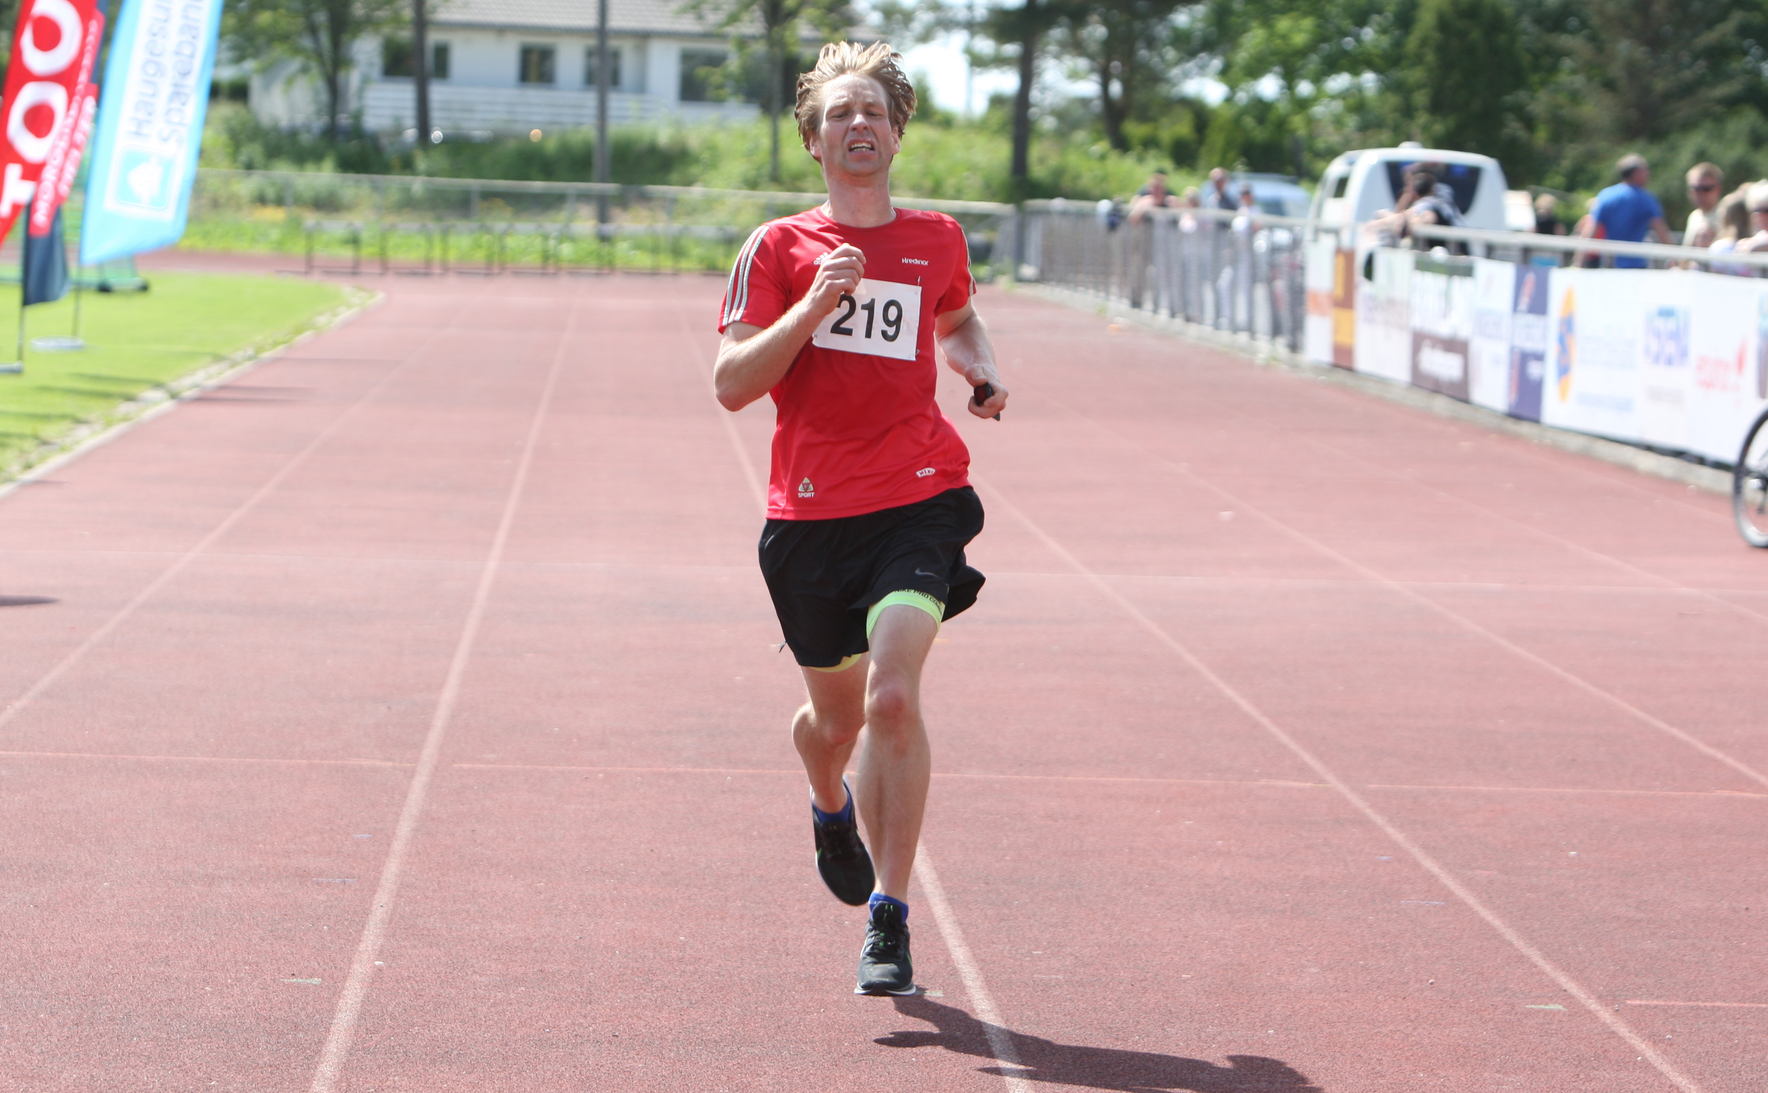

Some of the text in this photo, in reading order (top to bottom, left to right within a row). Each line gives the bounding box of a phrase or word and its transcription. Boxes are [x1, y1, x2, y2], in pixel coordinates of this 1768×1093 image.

[129, 0, 173, 138] Haugesu
[156, 0, 207, 144] Spareban
[830, 291, 903, 343] 219
